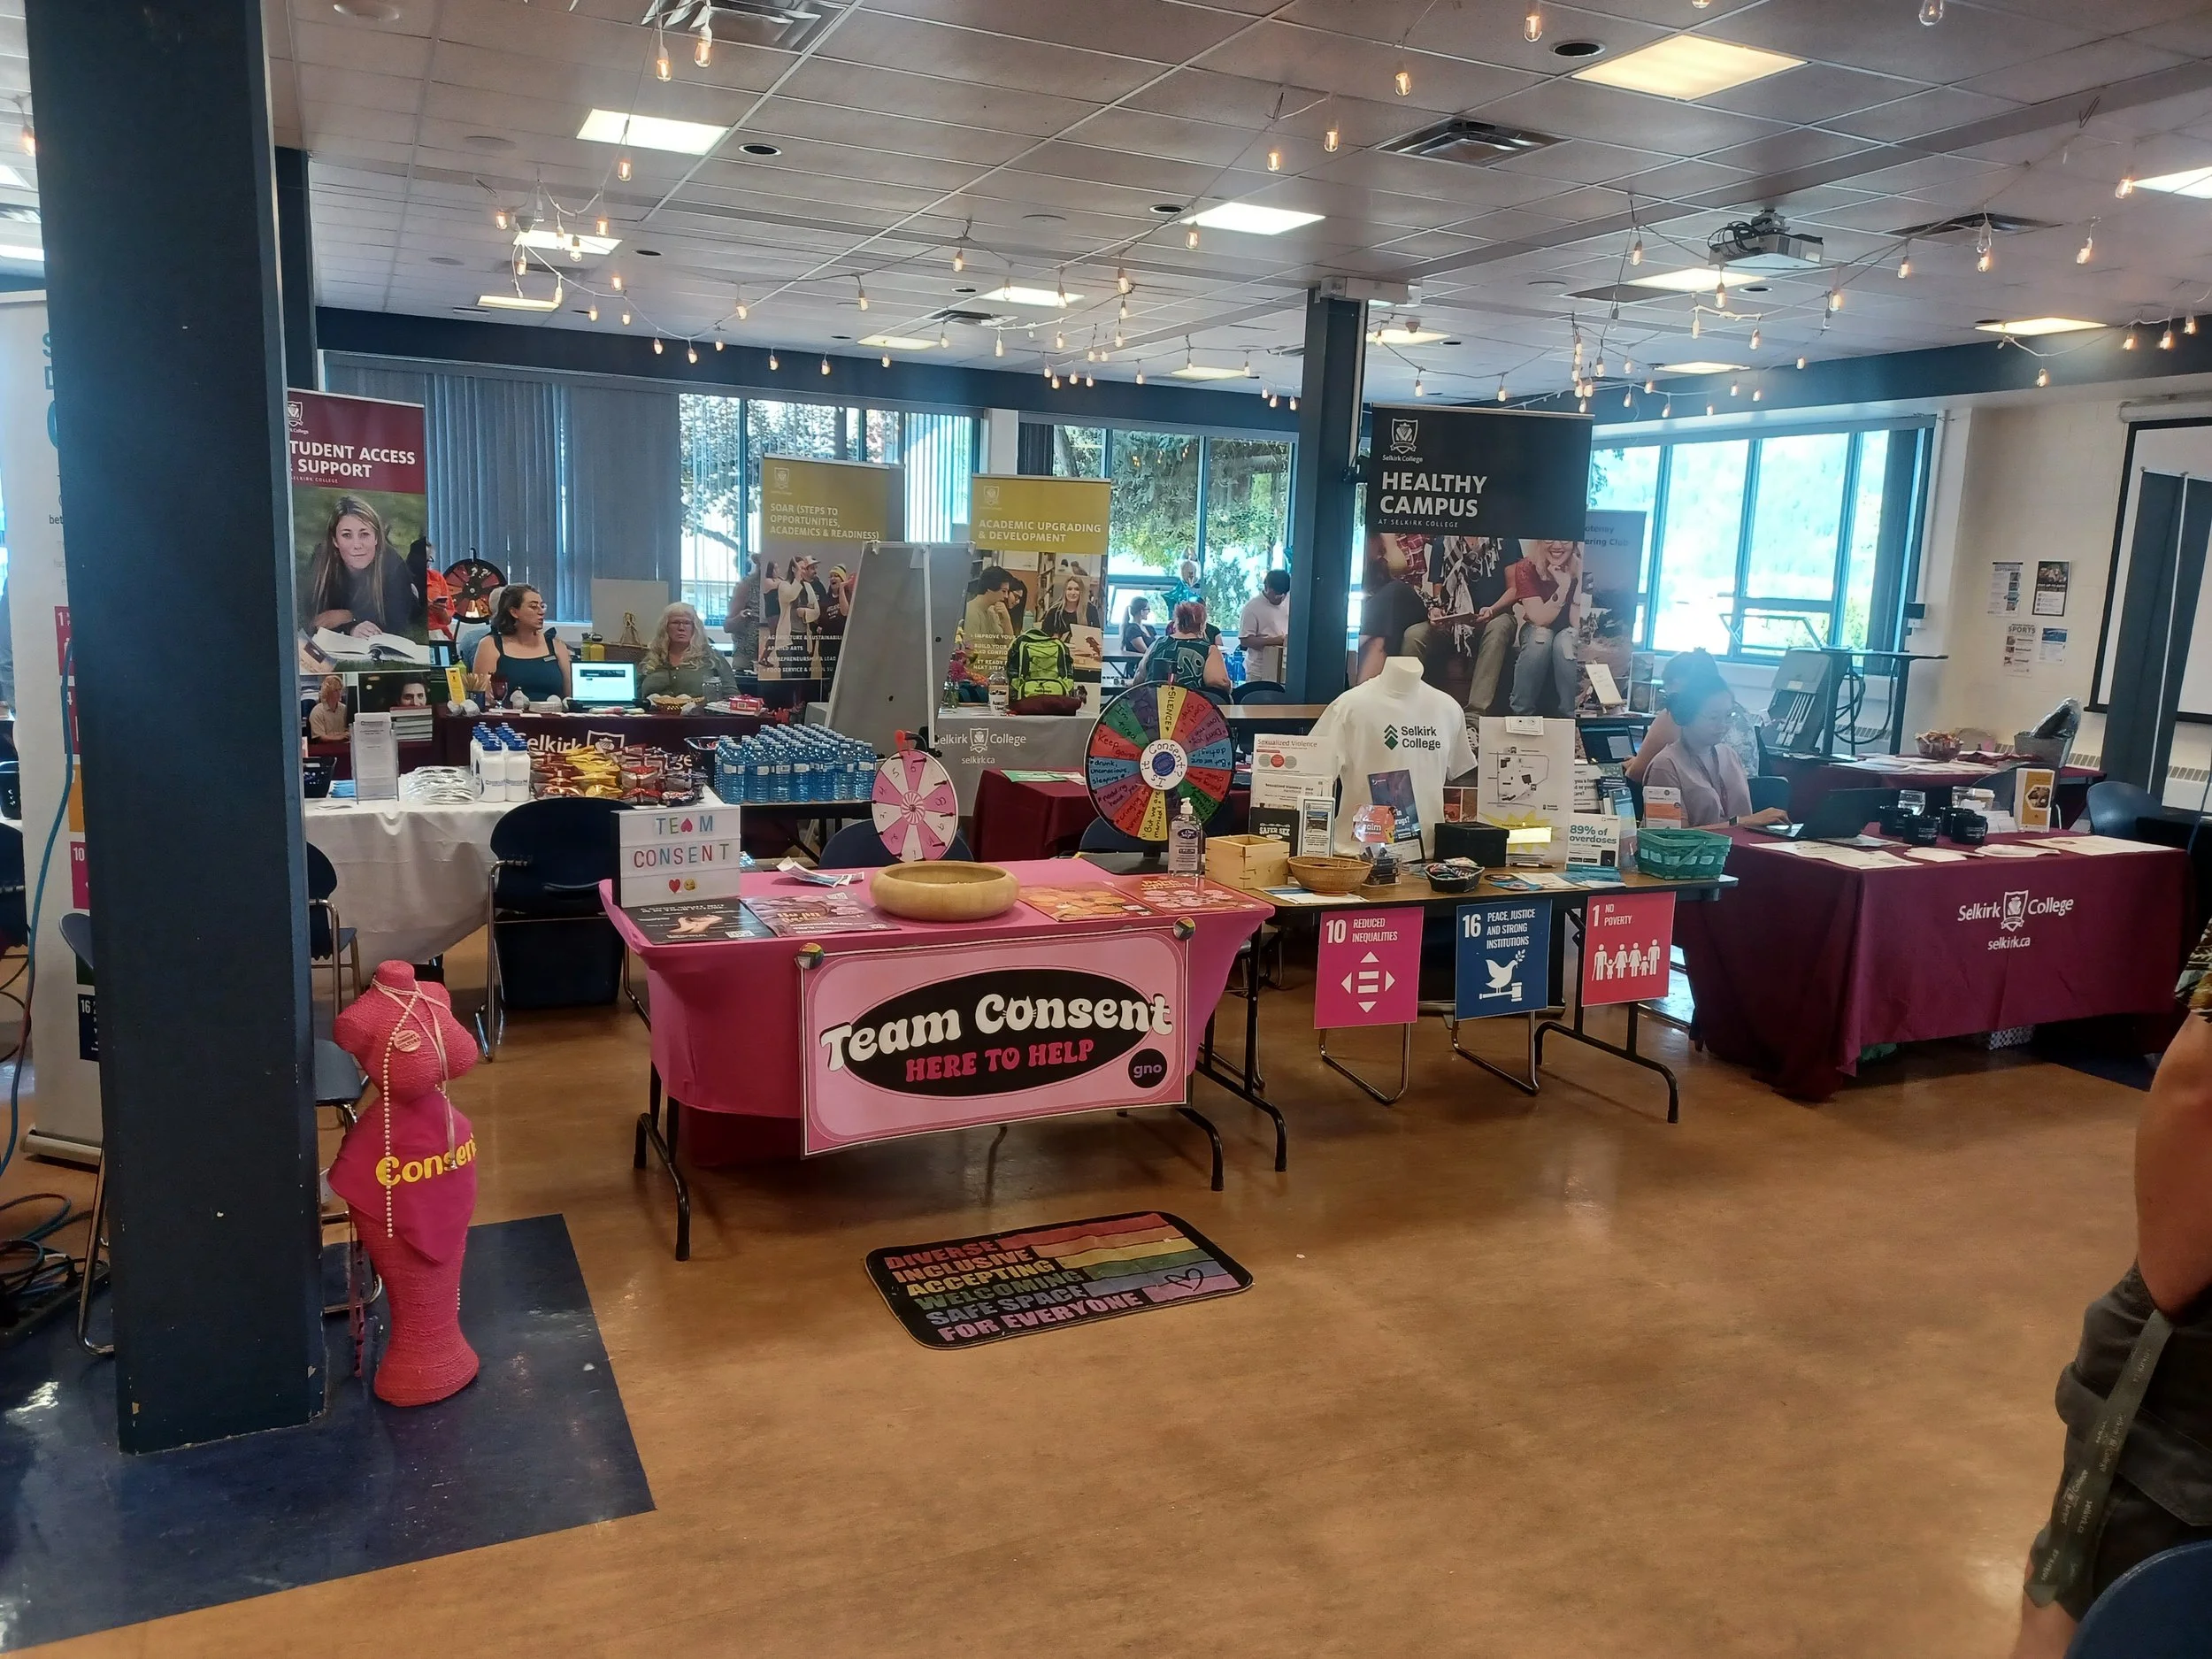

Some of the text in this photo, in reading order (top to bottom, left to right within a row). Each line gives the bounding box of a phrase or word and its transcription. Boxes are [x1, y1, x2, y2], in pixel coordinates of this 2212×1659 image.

[289, 440, 416, 465] TUDENT ACCESS
[1402, 455, 1423, 464] College
[298, 458, 372, 478] SUPPORT
[1382, 472, 1488, 494] HEALTHY
[770, 503, 795, 513] SOAR
[796, 504, 825, 515] (STEPS
[1380, 495, 1478, 518] CAMPUS
[50, 515, 64, 524] bet
[770, 515, 841, 527] OPPORTUNITIES,
[979, 519, 1102, 533] ACADEMIC UPGRADING
[770, 526, 820, 537] ACADEMICS
[831, 531, 879, 540] READINESS)
[979, 531, 1066, 542] & DEVELOPMENT
[1585, 538, 1607, 547] ering
[1402, 726, 1437, 736] Selkirk
[526, 734, 582, 752] elkirk
[989, 733, 1026, 747] College
[1258, 738, 1290, 747] Sexualized
[1402, 738, 1440, 750] College
[961, 756, 995, 764] selkirk.ca
[1149, 742, 1183, 779] Consent?
[1394, 816, 1410, 826] rugs?
[1259, 826, 1290, 836] SAFER SEX
[1570, 825, 1609, 837] 89% of
[1570, 835, 1617, 844] overdoses
[73, 847, 85, 862] 10
[634, 844, 729, 868] CONSENT
[1593, 903, 1615, 927] 1 NO
[1957, 897, 2074, 922] Selkirk College
[1462, 908, 1536, 938] 16 PEACE, JUSTICE
[1603, 915, 1632, 927] POVERTY
[1325, 918, 1386, 944] 10 REDUCED
[1486, 922, 1527, 936] AND STRONG
[1352, 931, 1398, 943] INEQUALITIES
[1486, 936, 1529, 949] INSTITUTIONS
[1987, 936, 2032, 950] selkirk.ca
[81, 1000, 90, 1014] 16
[819, 991, 1173, 1072] Team Consent
[905, 1039, 1095, 1083] HERE TO HELP
[1133, 1060, 1163, 1079] gno
[884, 1239, 1000, 1271] DIVERSE
[892, 1248, 1033, 1283] INCLUSIVE
[906, 1258, 1056, 1297] ACCEPTING
[913, 1271, 1085, 1310] WELCOMING
[926, 1285, 1087, 1325] SAFE SPACE
[937, 1292, 1144, 1343] FOR EVERYONE
